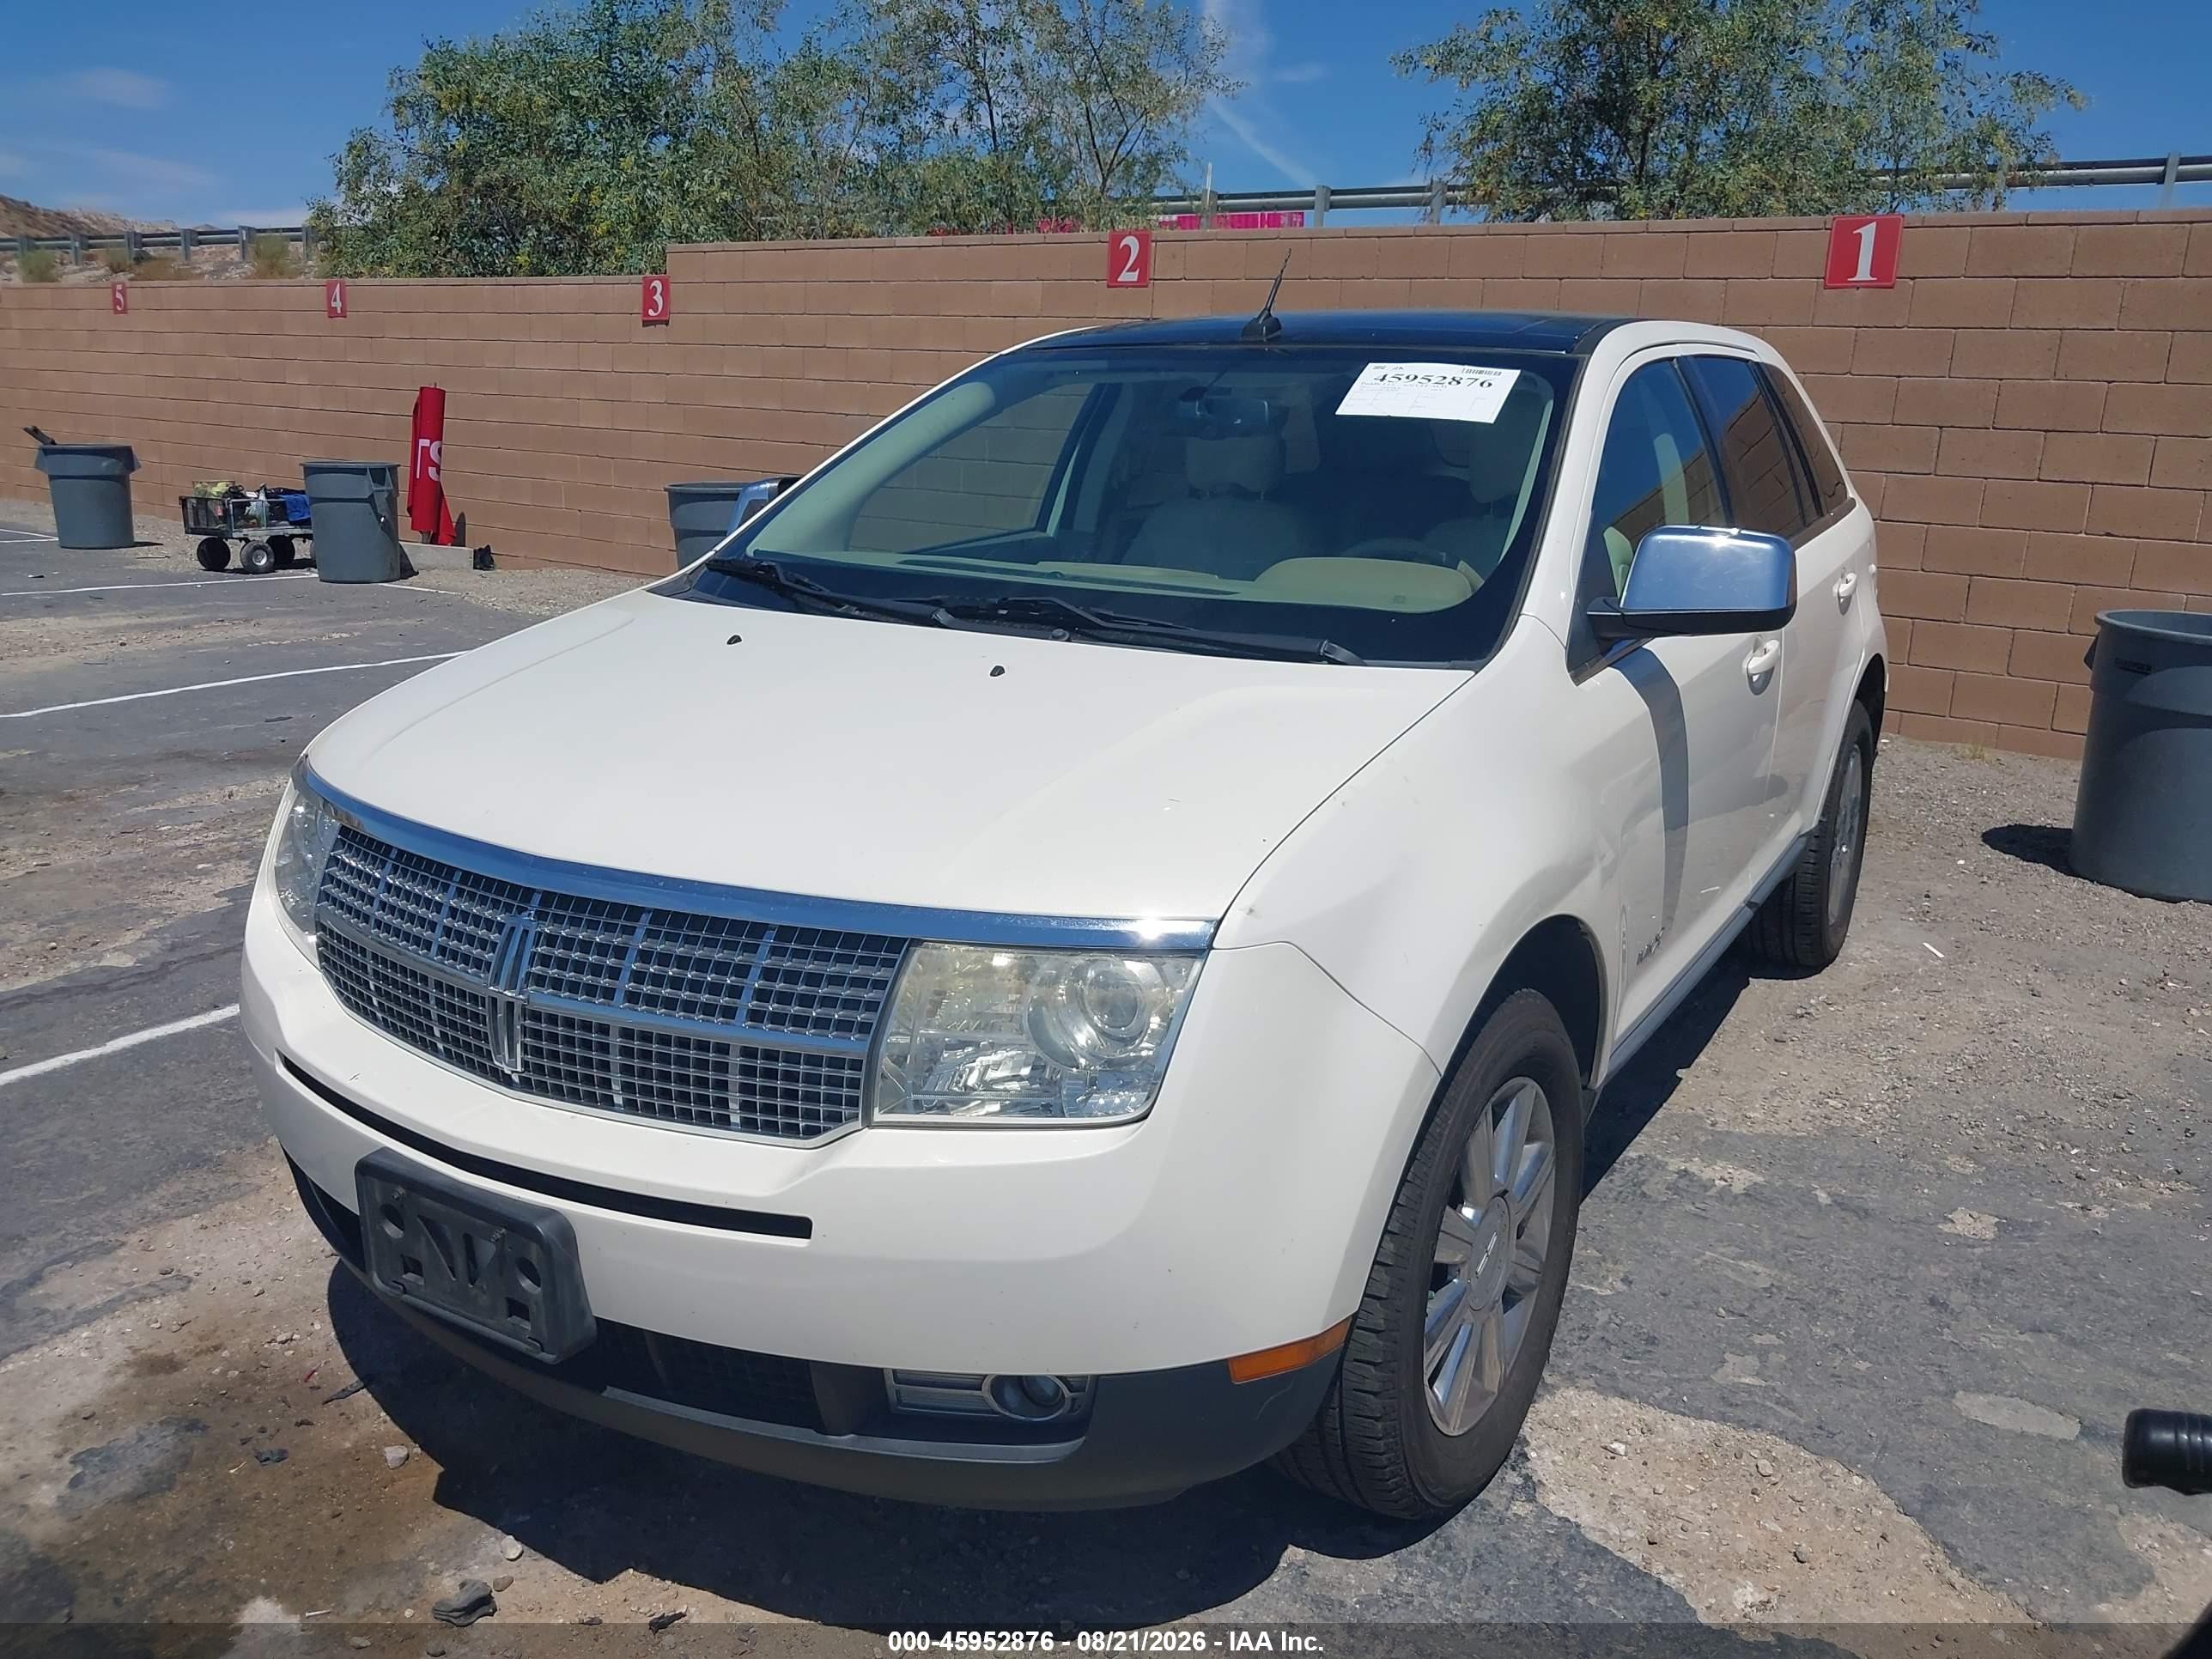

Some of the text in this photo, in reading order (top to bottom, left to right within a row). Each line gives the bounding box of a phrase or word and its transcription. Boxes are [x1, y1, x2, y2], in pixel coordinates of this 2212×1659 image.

[1117, 235, 1140, 282] 2
[1847, 222, 1878, 281] 1
[115, 284, 125, 311] 5
[331, 283, 343, 313] 4
[647, 280, 664, 317] 3
[1374, 373, 1493, 389] 45952876
